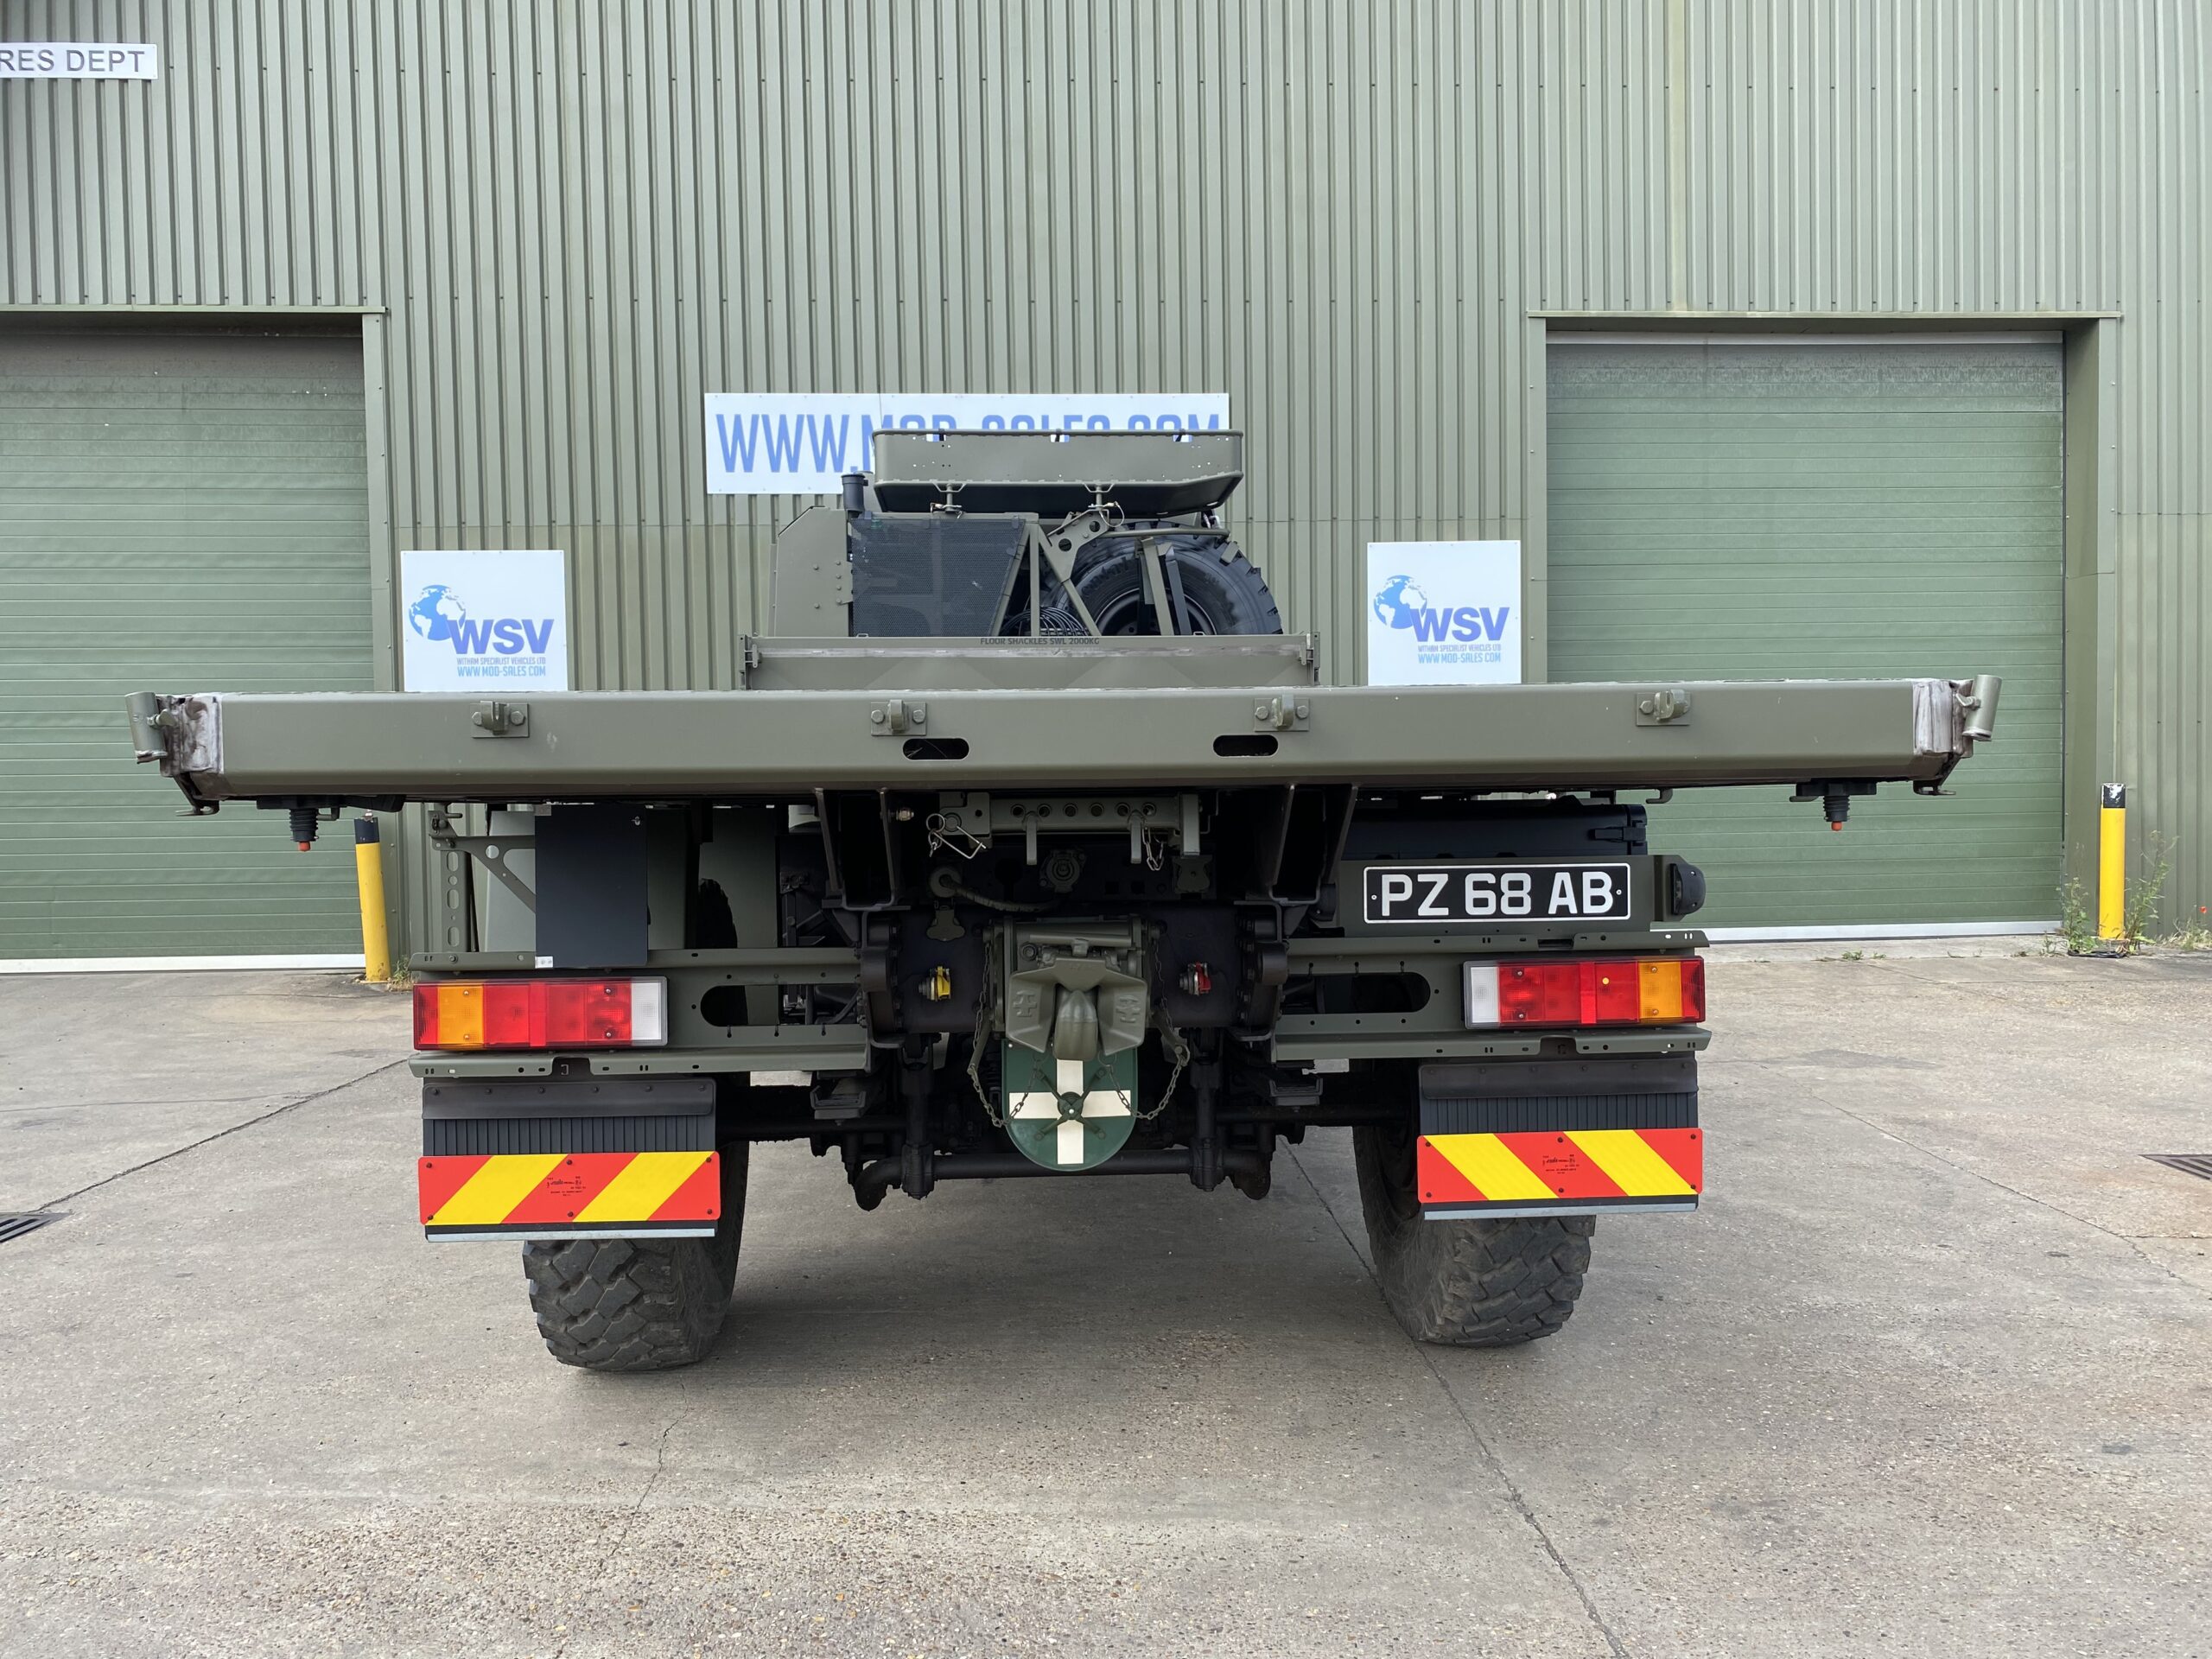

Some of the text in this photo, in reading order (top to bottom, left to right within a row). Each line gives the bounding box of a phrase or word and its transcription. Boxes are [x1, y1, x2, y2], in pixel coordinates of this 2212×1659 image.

[67, 49, 145, 73] DEPT
[447, 619, 555, 655] WSV
[1409, 607, 1510, 643] WSV
[980, 637, 1100, 645] FLOOR SHACKLES SWL 2000KG
[480, 657, 510, 665] SPECIALIST
[512, 657, 536, 665] VEHICLES
[1381, 871, 1614, 917] PZ 68 AB
